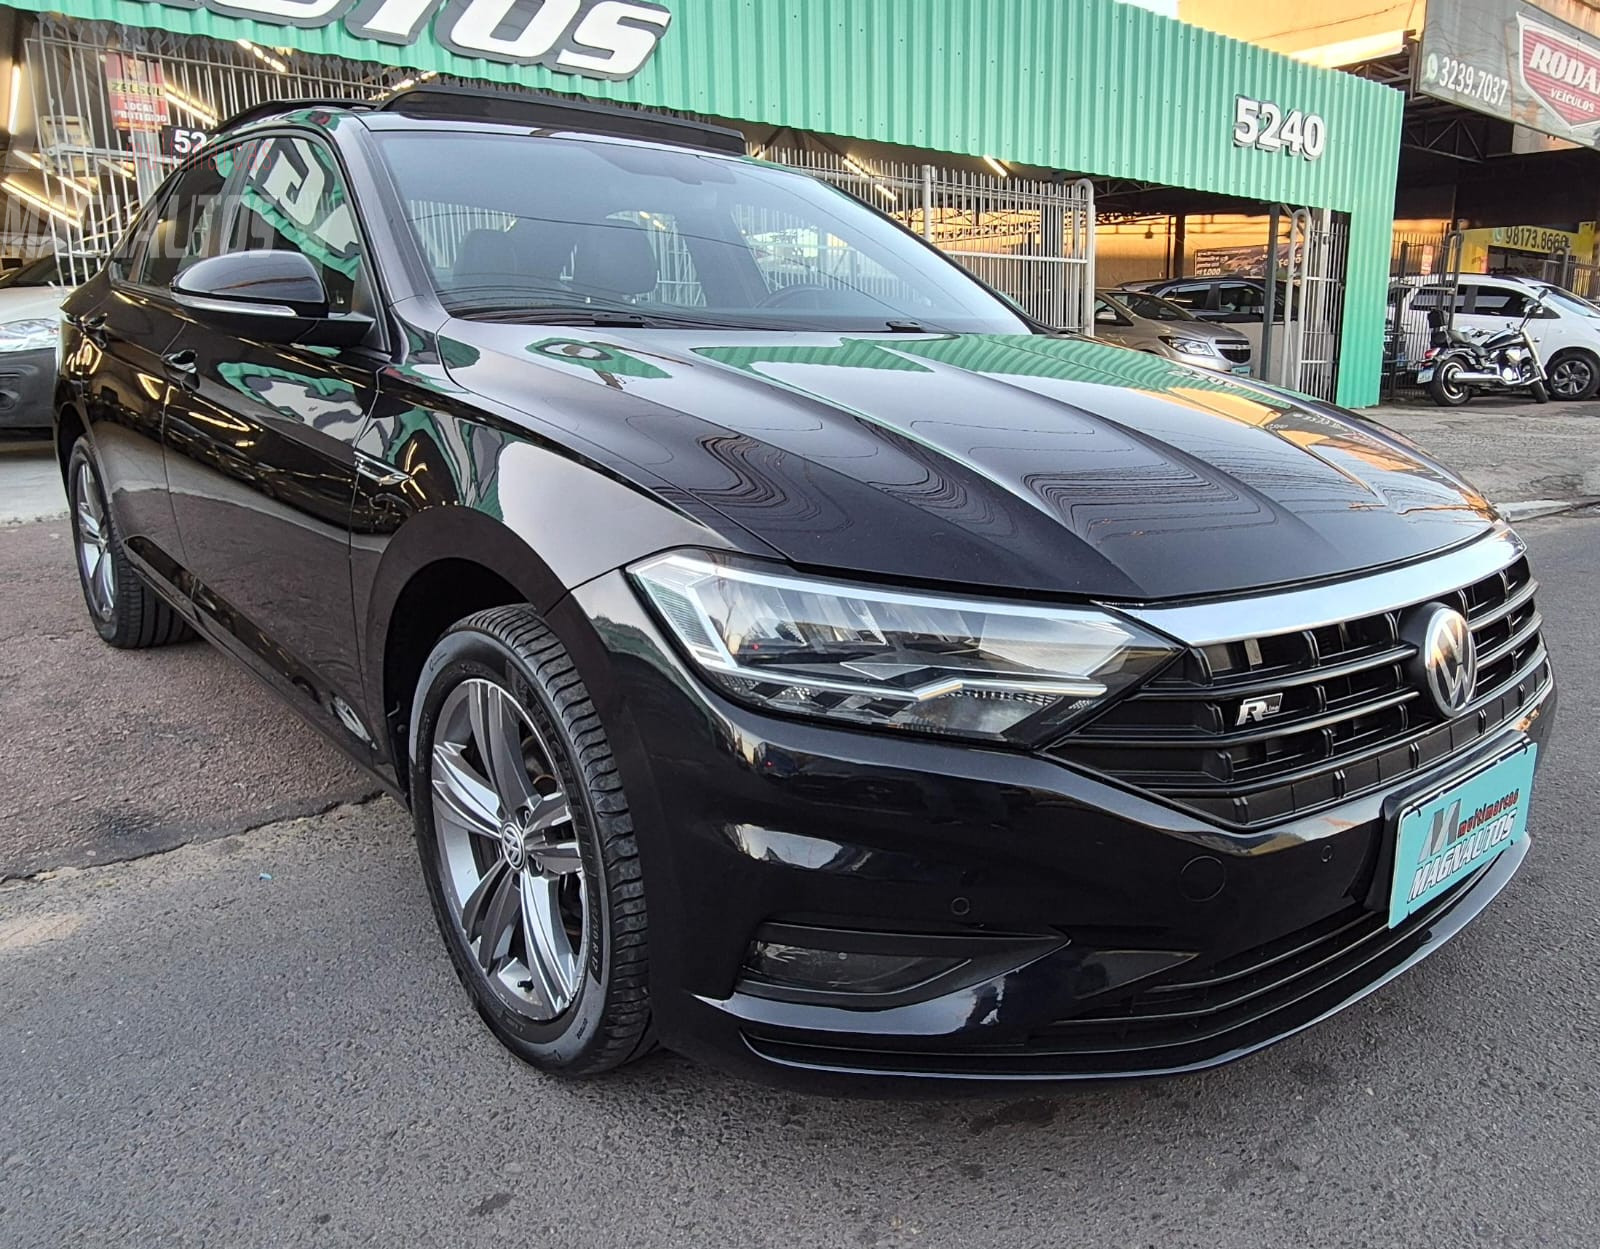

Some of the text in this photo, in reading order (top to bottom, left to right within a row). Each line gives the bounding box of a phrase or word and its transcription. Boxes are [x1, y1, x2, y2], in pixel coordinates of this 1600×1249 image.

[1439, 56, 1509, 107] 3239.7037
[1529, 42, 1600, 97] RODA
[1232, 94, 1326, 161] 5240
[1457, 788, 1519, 838] multimarcas
[1407, 806, 1517, 904] MAGNAUTOS
